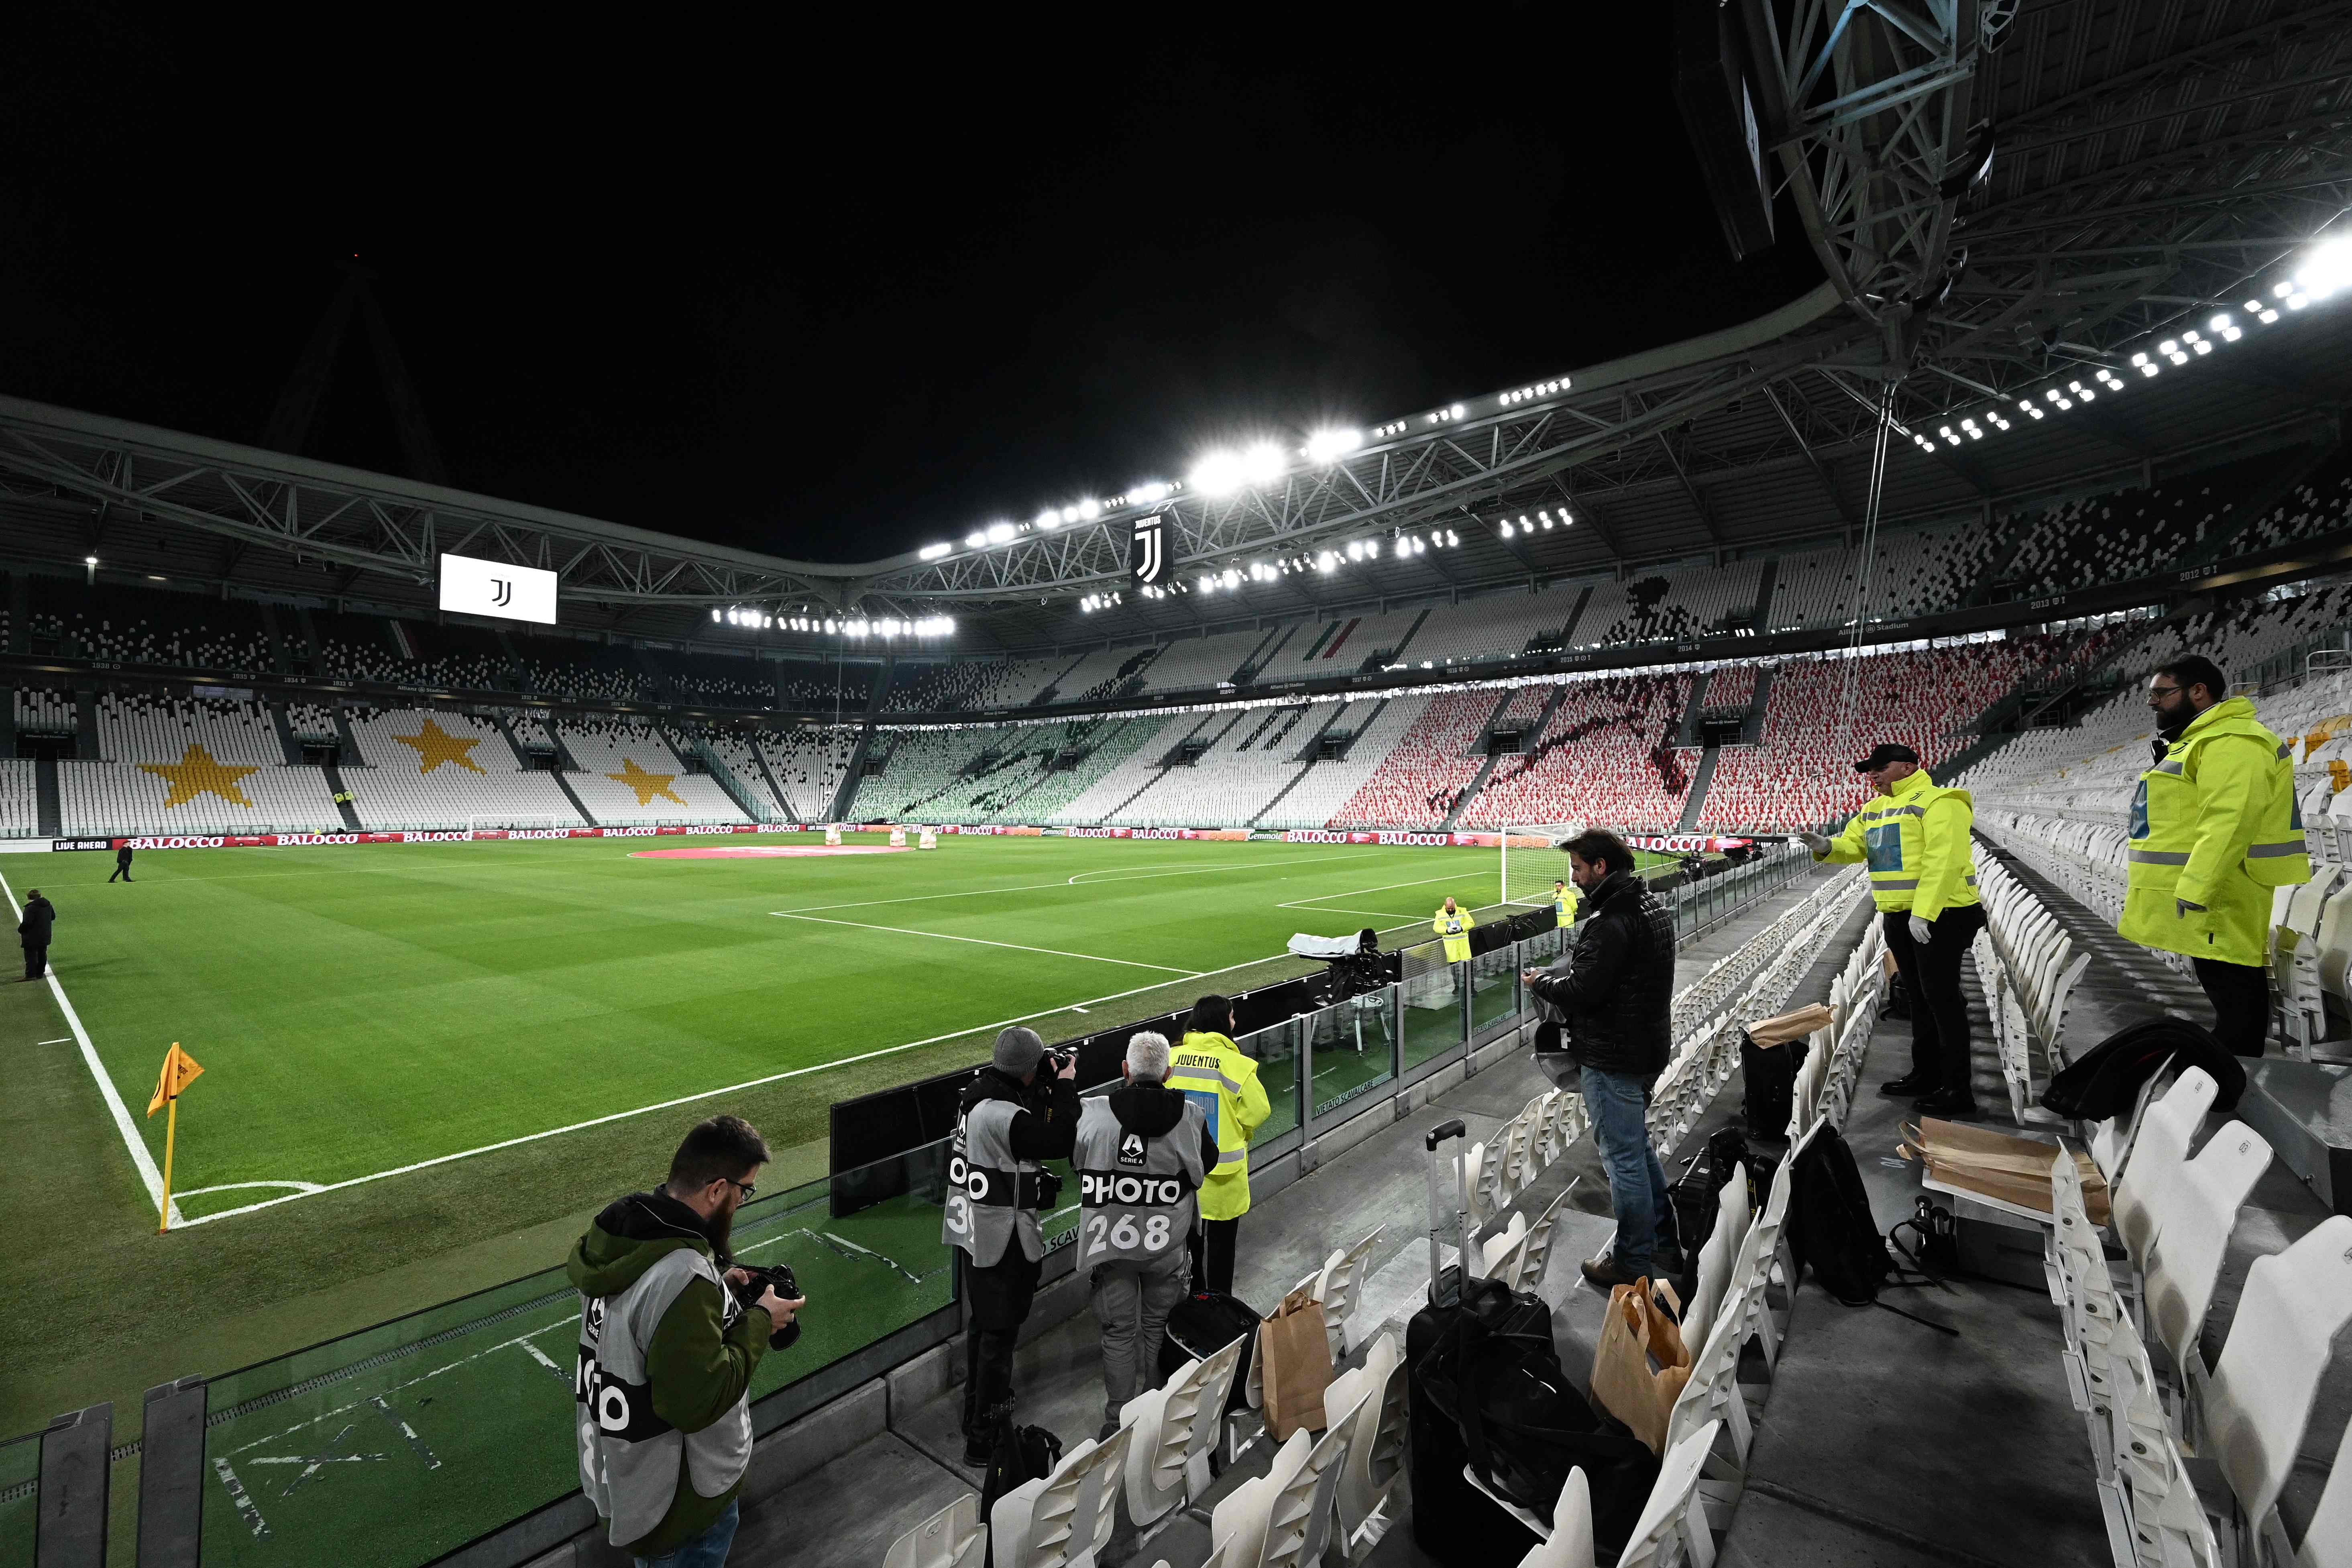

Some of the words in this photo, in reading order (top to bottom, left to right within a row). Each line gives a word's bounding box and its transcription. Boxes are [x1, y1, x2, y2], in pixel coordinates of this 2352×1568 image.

[1135, 515, 1161, 529] JUVENTUS
[2180, 570, 2199, 581] 2012
[2031, 599, 2049, 609] 2013
[1877, 623, 1908, 631] Stadium
[509, 829, 569, 839] BALOCCO
[603, 827, 656, 837] BALOCCO
[686, 825, 733, 834] BALOCCO
[758, 824, 800, 833] BALOCCO
[959, 826, 992, 835] BALOCCO
[1041, 828, 1066, 836] Gemmole
[1069, 828, 1110, 838] BALOCCO
[277, 834, 358, 845] BALOCCO
[403, 831, 470, 842] BALOCCO
[1132, 829, 1178, 840] BALOCCO
[1248, 832, 1283, 841] Gemmole
[1287, 832, 1347, 843] BALOCCO
[1379, 833, 1447, 846] BALOCCO
[56, 841, 75, 850] LIVE
[77, 841, 106, 849] AHEAD
[129, 837, 224, 849] BALOCCO
[1626, 837, 1706, 852] ALOCCO
[1176, 1055, 1220, 1069] JUVENTUS
[1317, 1097, 1339, 1115] VIETATO
[1341, 1080, 1374, 1102] SCAVALCARE
[1082, 1175, 1179, 1204] PHOTO
[1086, 1214, 1170, 1257] 268
[588, 1322, 599, 1338] SERIE
